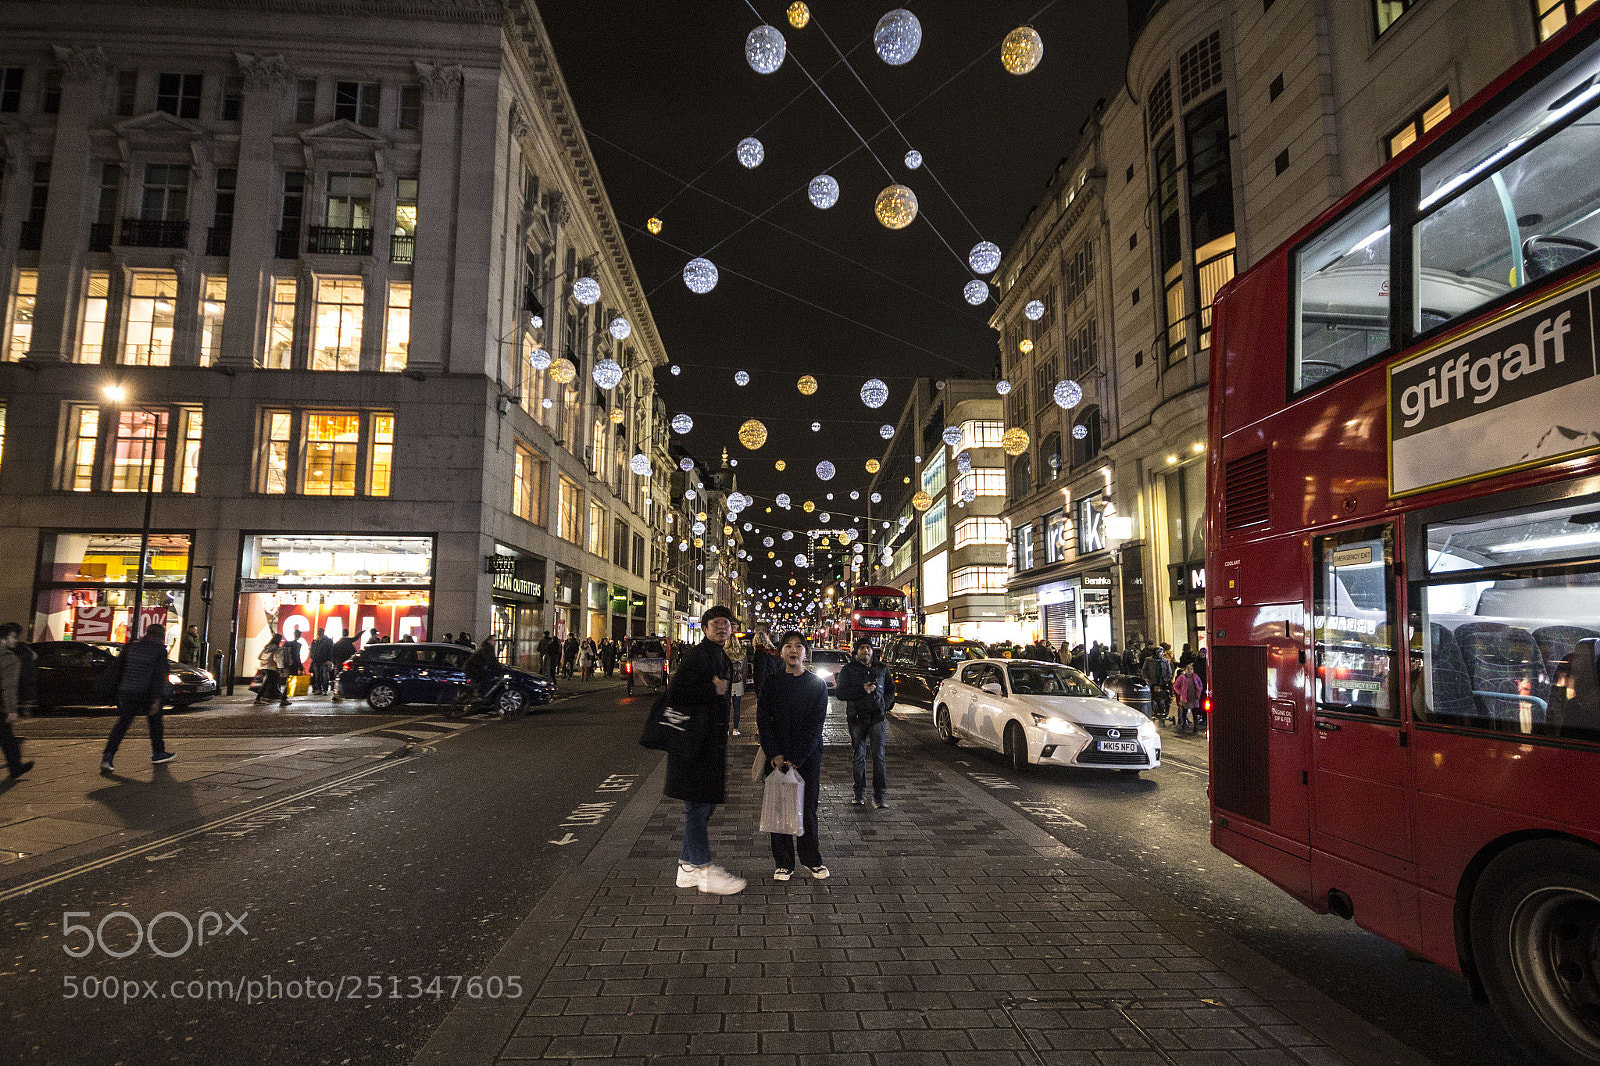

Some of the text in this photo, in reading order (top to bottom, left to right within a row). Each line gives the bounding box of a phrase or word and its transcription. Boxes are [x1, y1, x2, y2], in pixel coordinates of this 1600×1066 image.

[1401, 310, 1571, 428] giffgaff
[1224, 559, 1241, 567] COOLANT
[1334, 551, 1371, 562] EMERGENCY EXIT
[513, 578, 541, 597] OUTFITTERS
[1085, 577, 1111, 585] Bershka
[76, 607, 111, 641] SAL
[558, 774, 639, 827] LOOK LEFT
